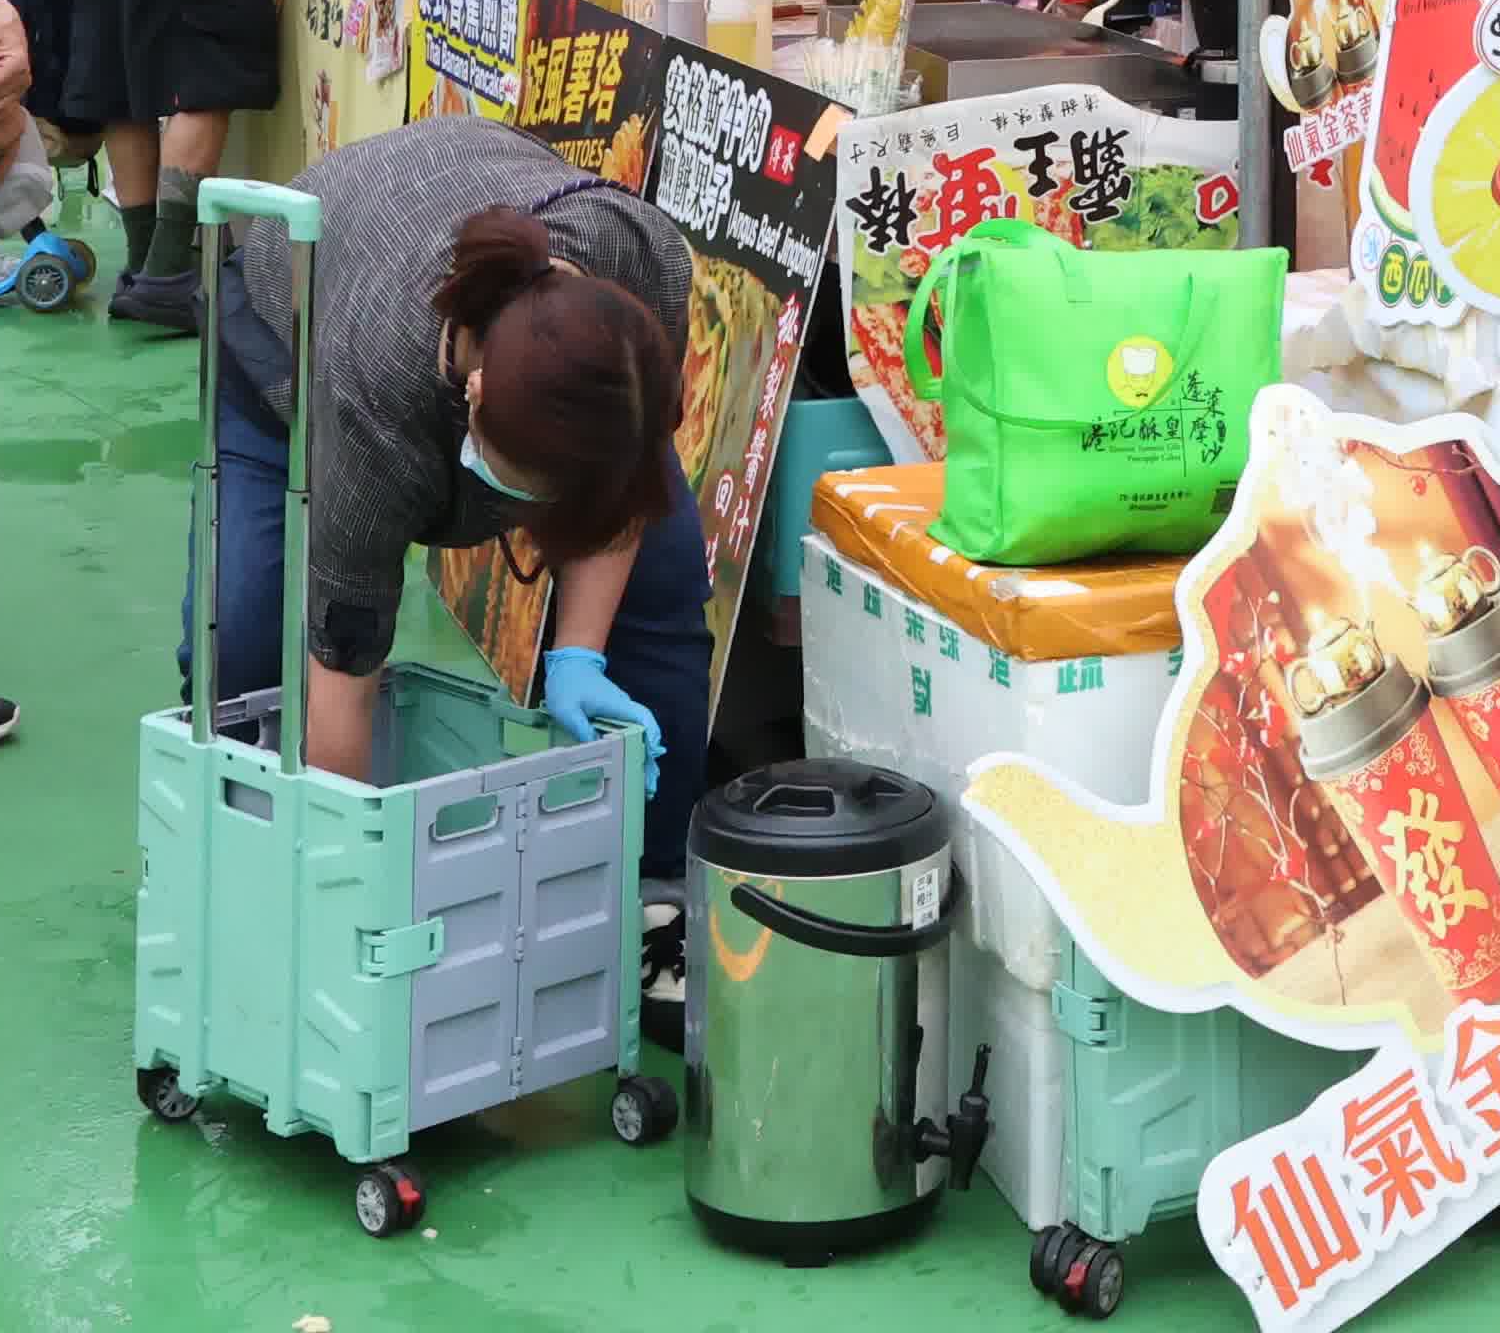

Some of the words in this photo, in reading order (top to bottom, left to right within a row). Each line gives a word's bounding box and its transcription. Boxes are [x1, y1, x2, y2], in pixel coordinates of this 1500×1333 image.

[426, 32, 441, 67] Thai
[442, 42, 469, 85] Banana
[524, 29, 629, 126] 旋風薯塔
[551, 139, 604, 170] OTATOES
[663, 54, 772, 173] 安格斯牛肉
[656, 132, 733, 240] 煎餅果子
[759, 215, 780, 259] Beef
[1379, 789, 1490, 939] 發
